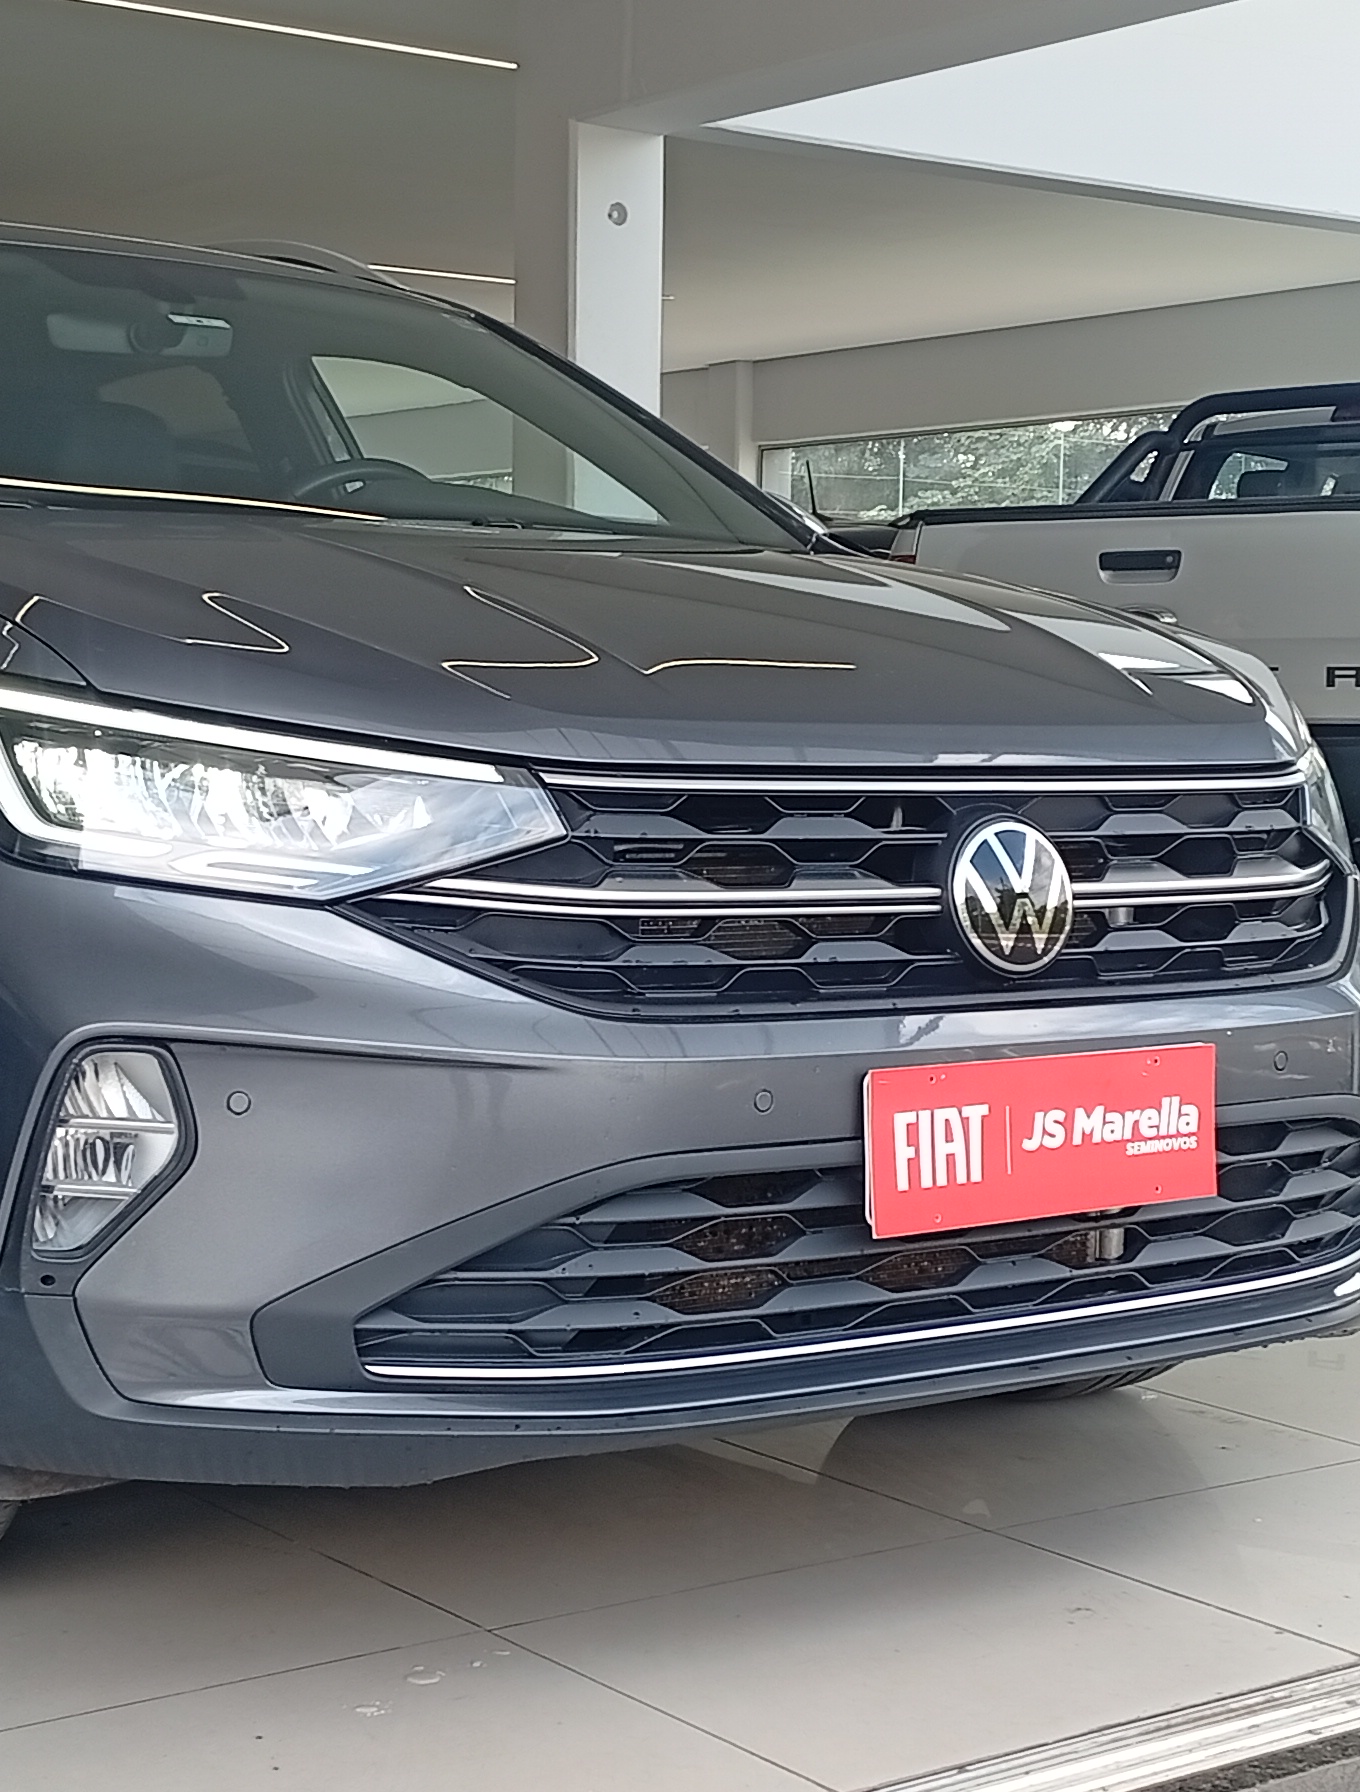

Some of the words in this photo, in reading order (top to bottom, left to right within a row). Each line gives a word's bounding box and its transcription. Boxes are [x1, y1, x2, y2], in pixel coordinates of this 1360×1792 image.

[893, 1103, 990, 1192] FIAT
[1021, 1109, 1066, 1151] JS
[1071, 1095, 1200, 1146] Marella
[1125, 1136, 1198, 1156] SEMINOVOS
